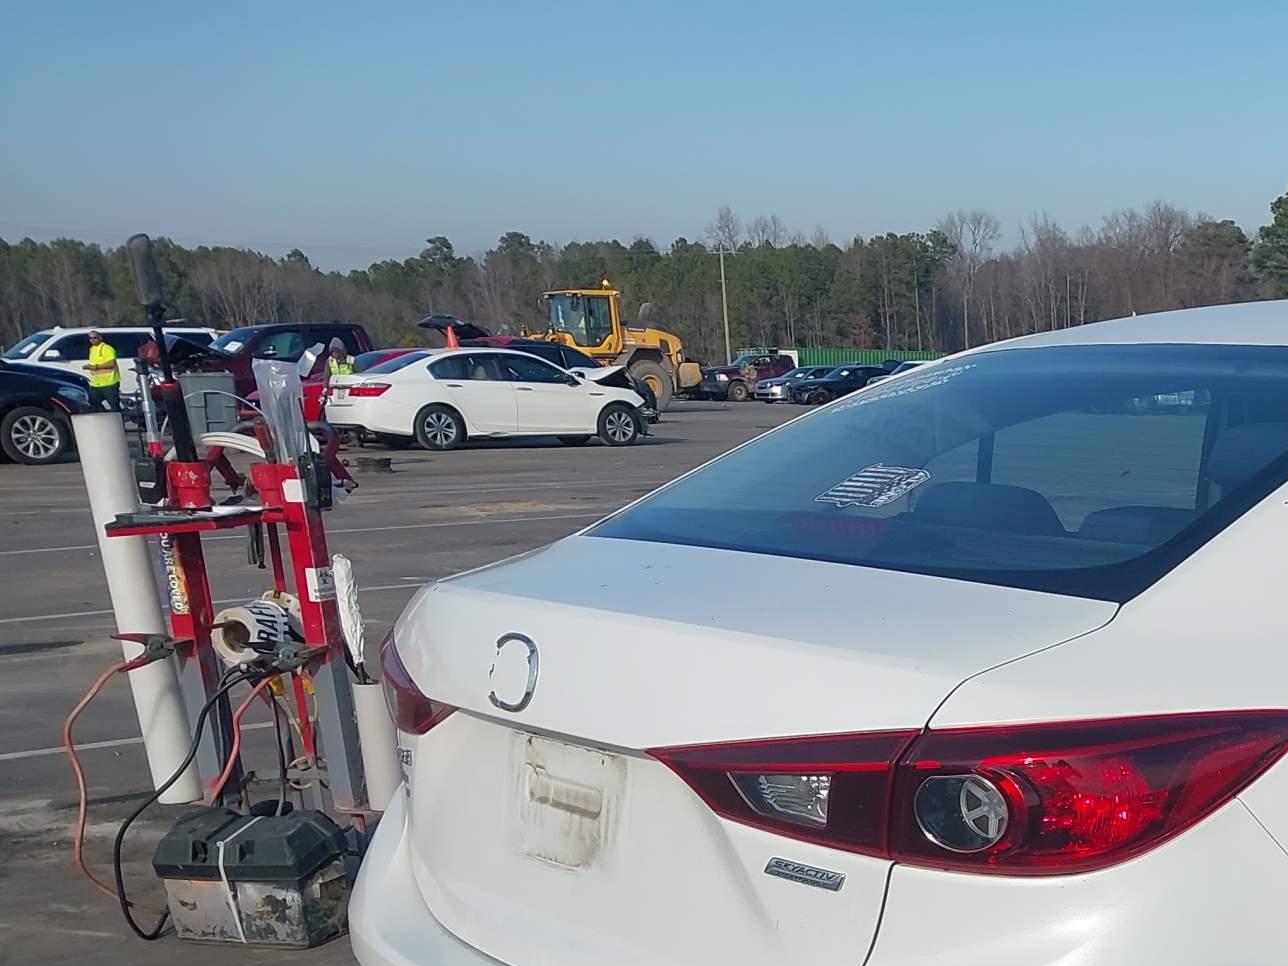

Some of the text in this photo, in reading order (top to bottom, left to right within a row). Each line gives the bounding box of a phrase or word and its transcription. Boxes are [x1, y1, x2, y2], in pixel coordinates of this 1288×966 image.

[163, 549, 175, 572] ARE
[169, 574, 183, 610] LOVED
[773, 860, 837, 881] SKYACTIV
